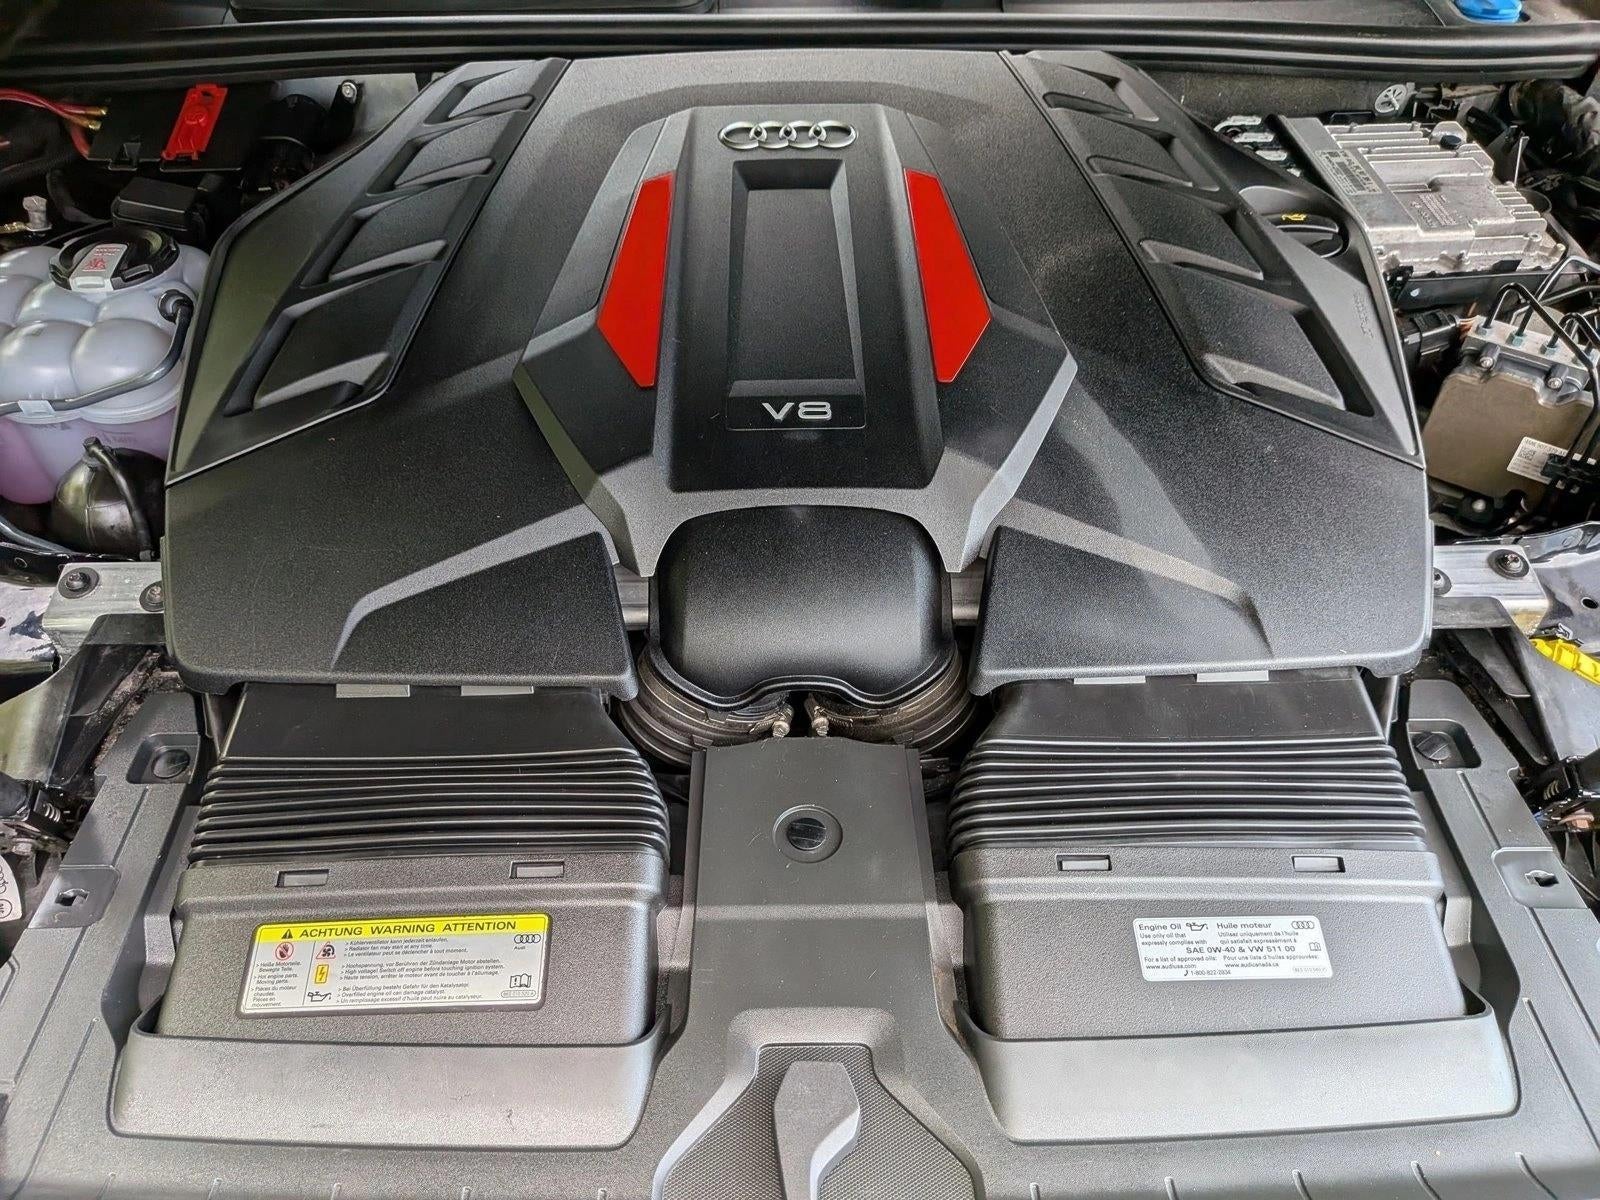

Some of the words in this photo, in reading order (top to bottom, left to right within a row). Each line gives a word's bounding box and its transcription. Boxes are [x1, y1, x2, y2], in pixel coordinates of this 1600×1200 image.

[762, 402, 832, 421] V8
[300, 926, 362, 938] ACHTUNG
[370, 924, 435, 935] WARNING
[442, 922, 516, 932] ATTENTION
